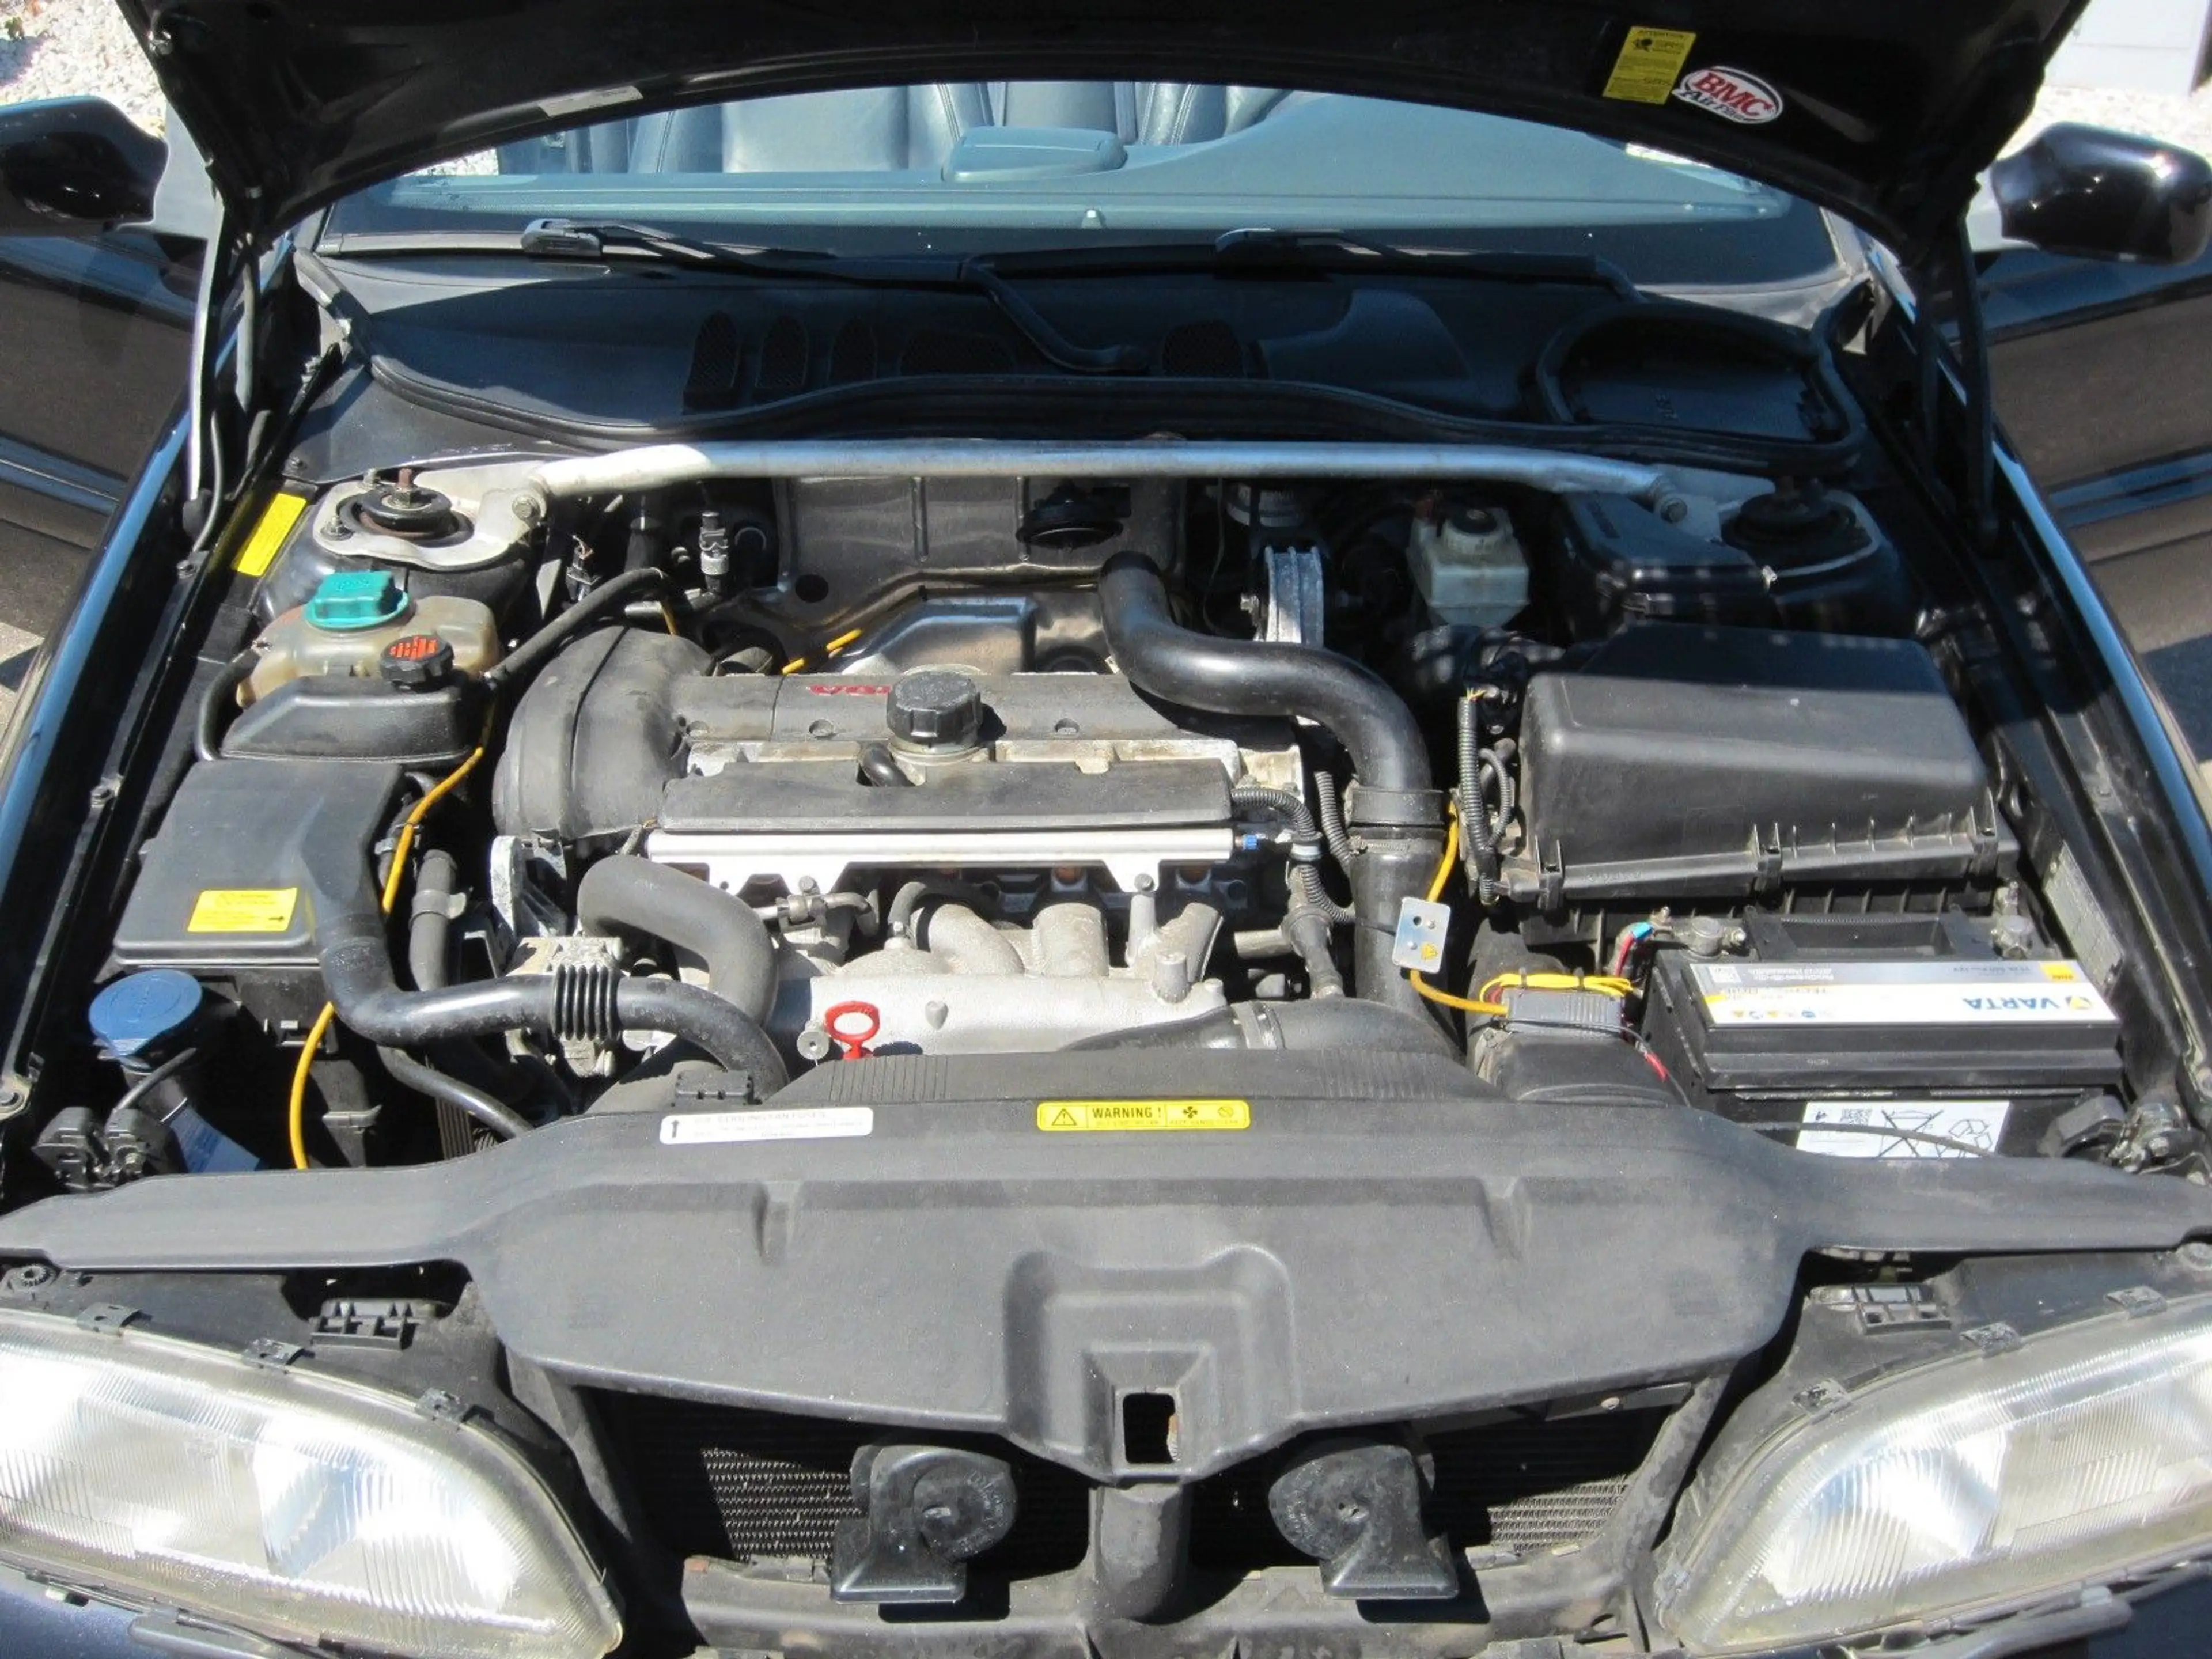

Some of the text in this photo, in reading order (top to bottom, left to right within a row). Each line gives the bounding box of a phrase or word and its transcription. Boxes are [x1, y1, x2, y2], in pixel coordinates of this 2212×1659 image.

[1692, 71, 1774, 116] BMC
[1962, 997, 2061, 1010] VARTA
[1092, 1107, 1153, 1118] WARNING
